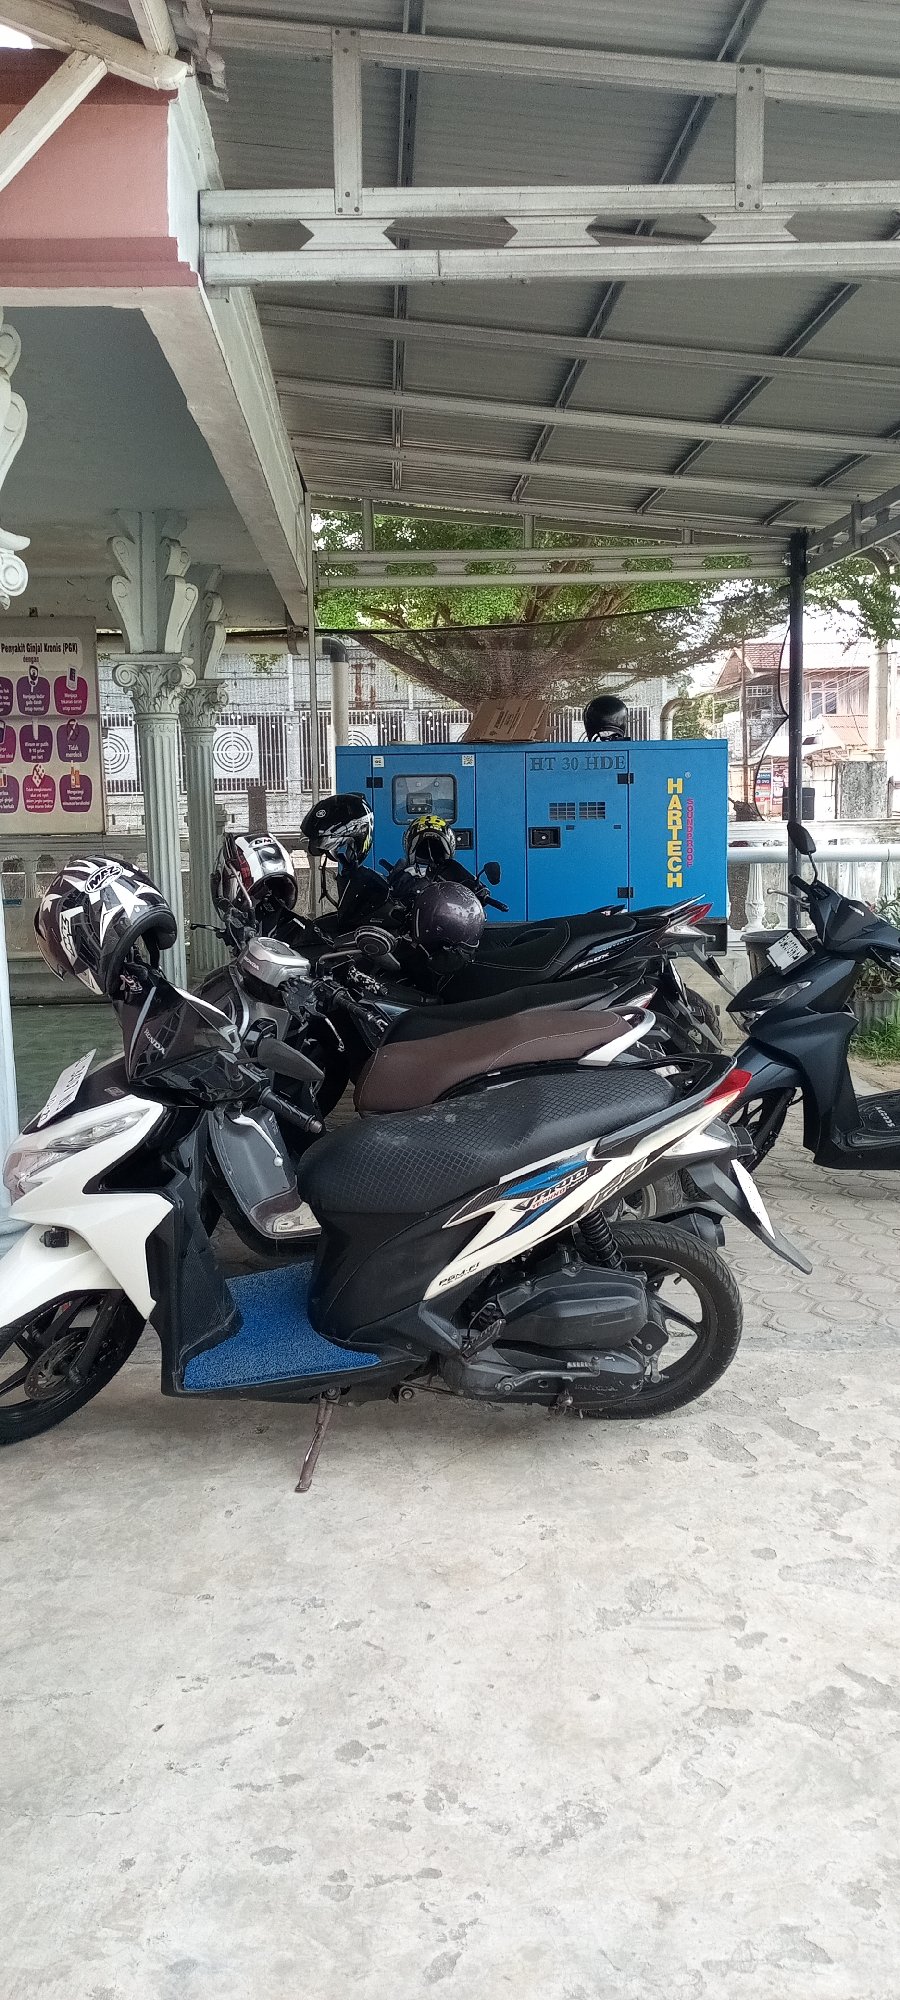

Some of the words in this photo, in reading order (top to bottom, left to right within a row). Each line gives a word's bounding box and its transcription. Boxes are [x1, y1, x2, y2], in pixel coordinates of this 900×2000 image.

[1, 643, 26, 654] Penyakit
[26, 643, 42, 654] Ginjal
[44, 643, 61, 653] Kronis
[63, 643, 78, 654] (PGK)
[530, 757, 556, 771] HT
[561, 757, 579, 771] 30
[585, 755, 626, 770] HDE
[667, 777, 683, 888] HARTECH
[686, 799, 694, 868] SOUNDPROOF
[143, 1027, 166, 1055] HONDA
